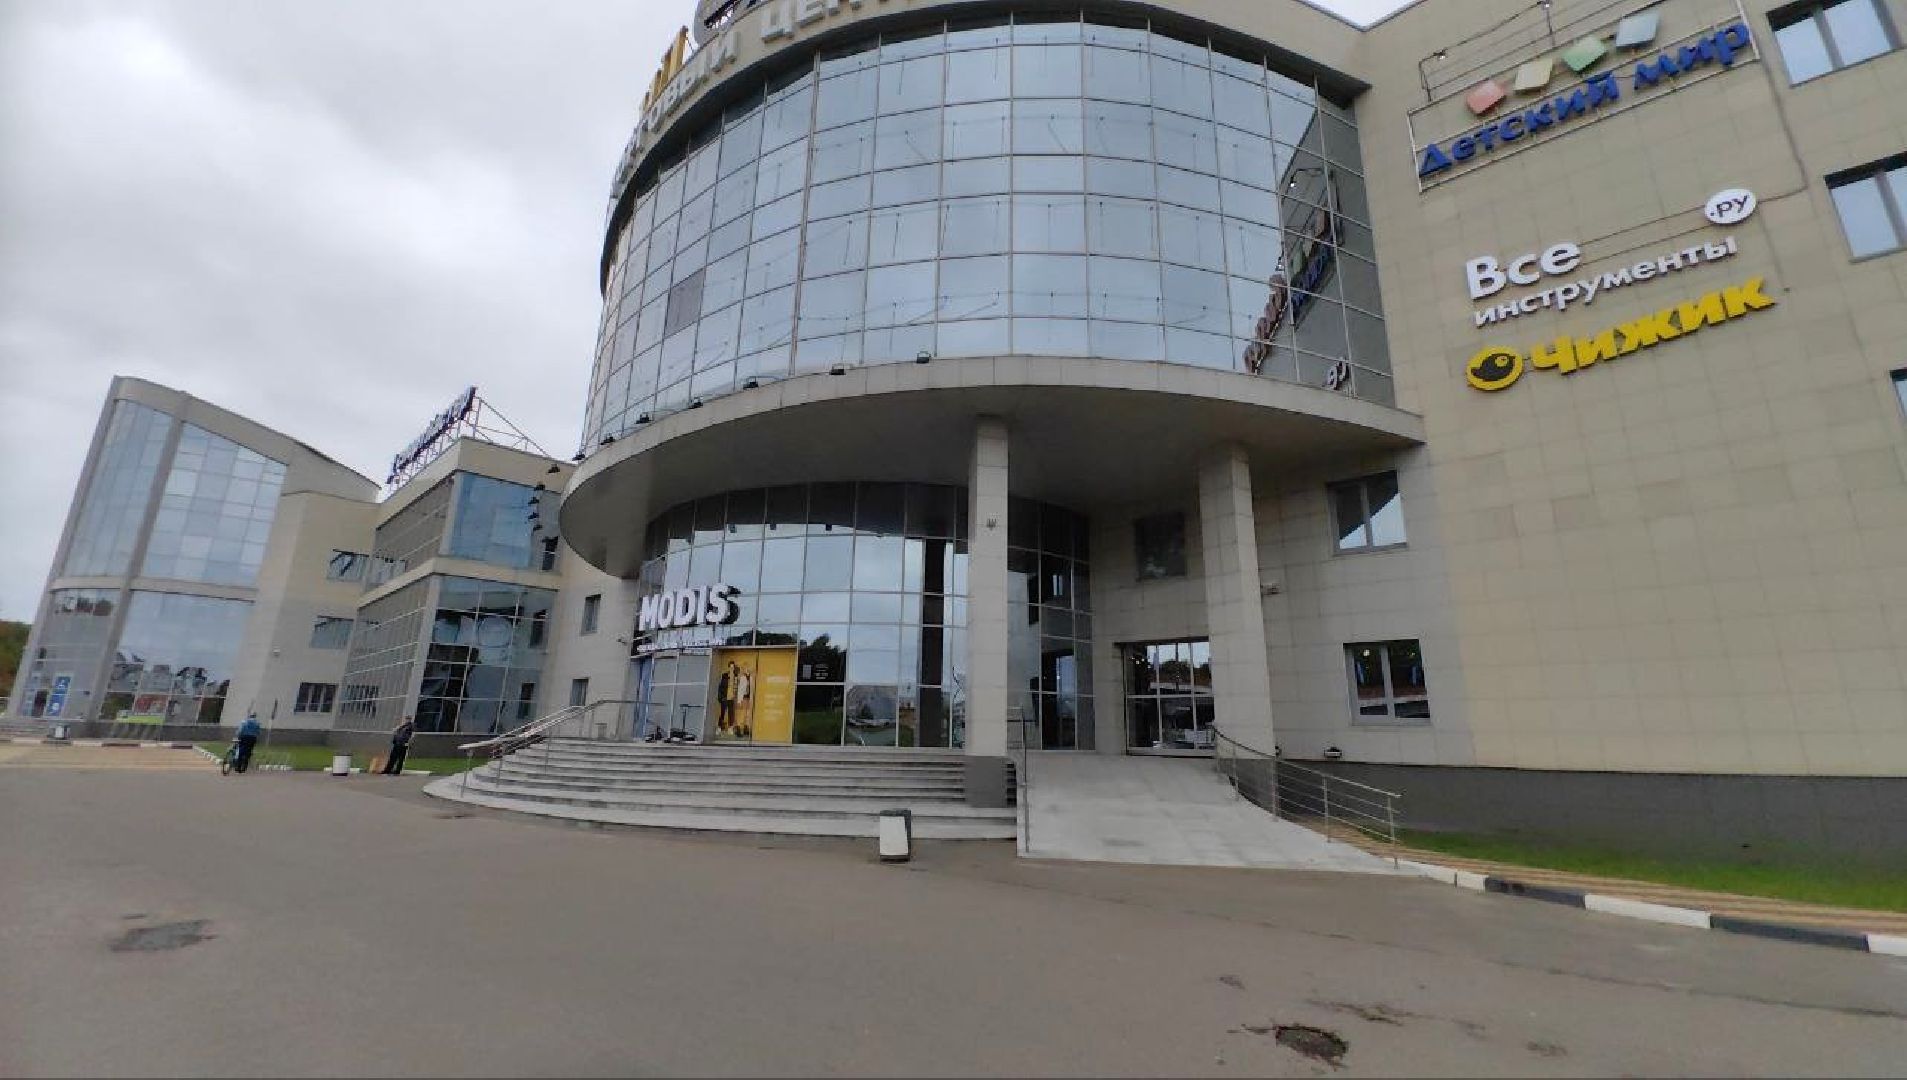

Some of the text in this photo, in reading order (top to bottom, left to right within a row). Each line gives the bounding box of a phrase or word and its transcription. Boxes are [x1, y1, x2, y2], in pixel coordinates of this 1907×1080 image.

[1419, 23, 1752, 176] Детский мир
[1466, 242, 1581, 300] Все
[1474, 236, 1738, 328] инструменты
[639, 583, 732, 632] MODIS
